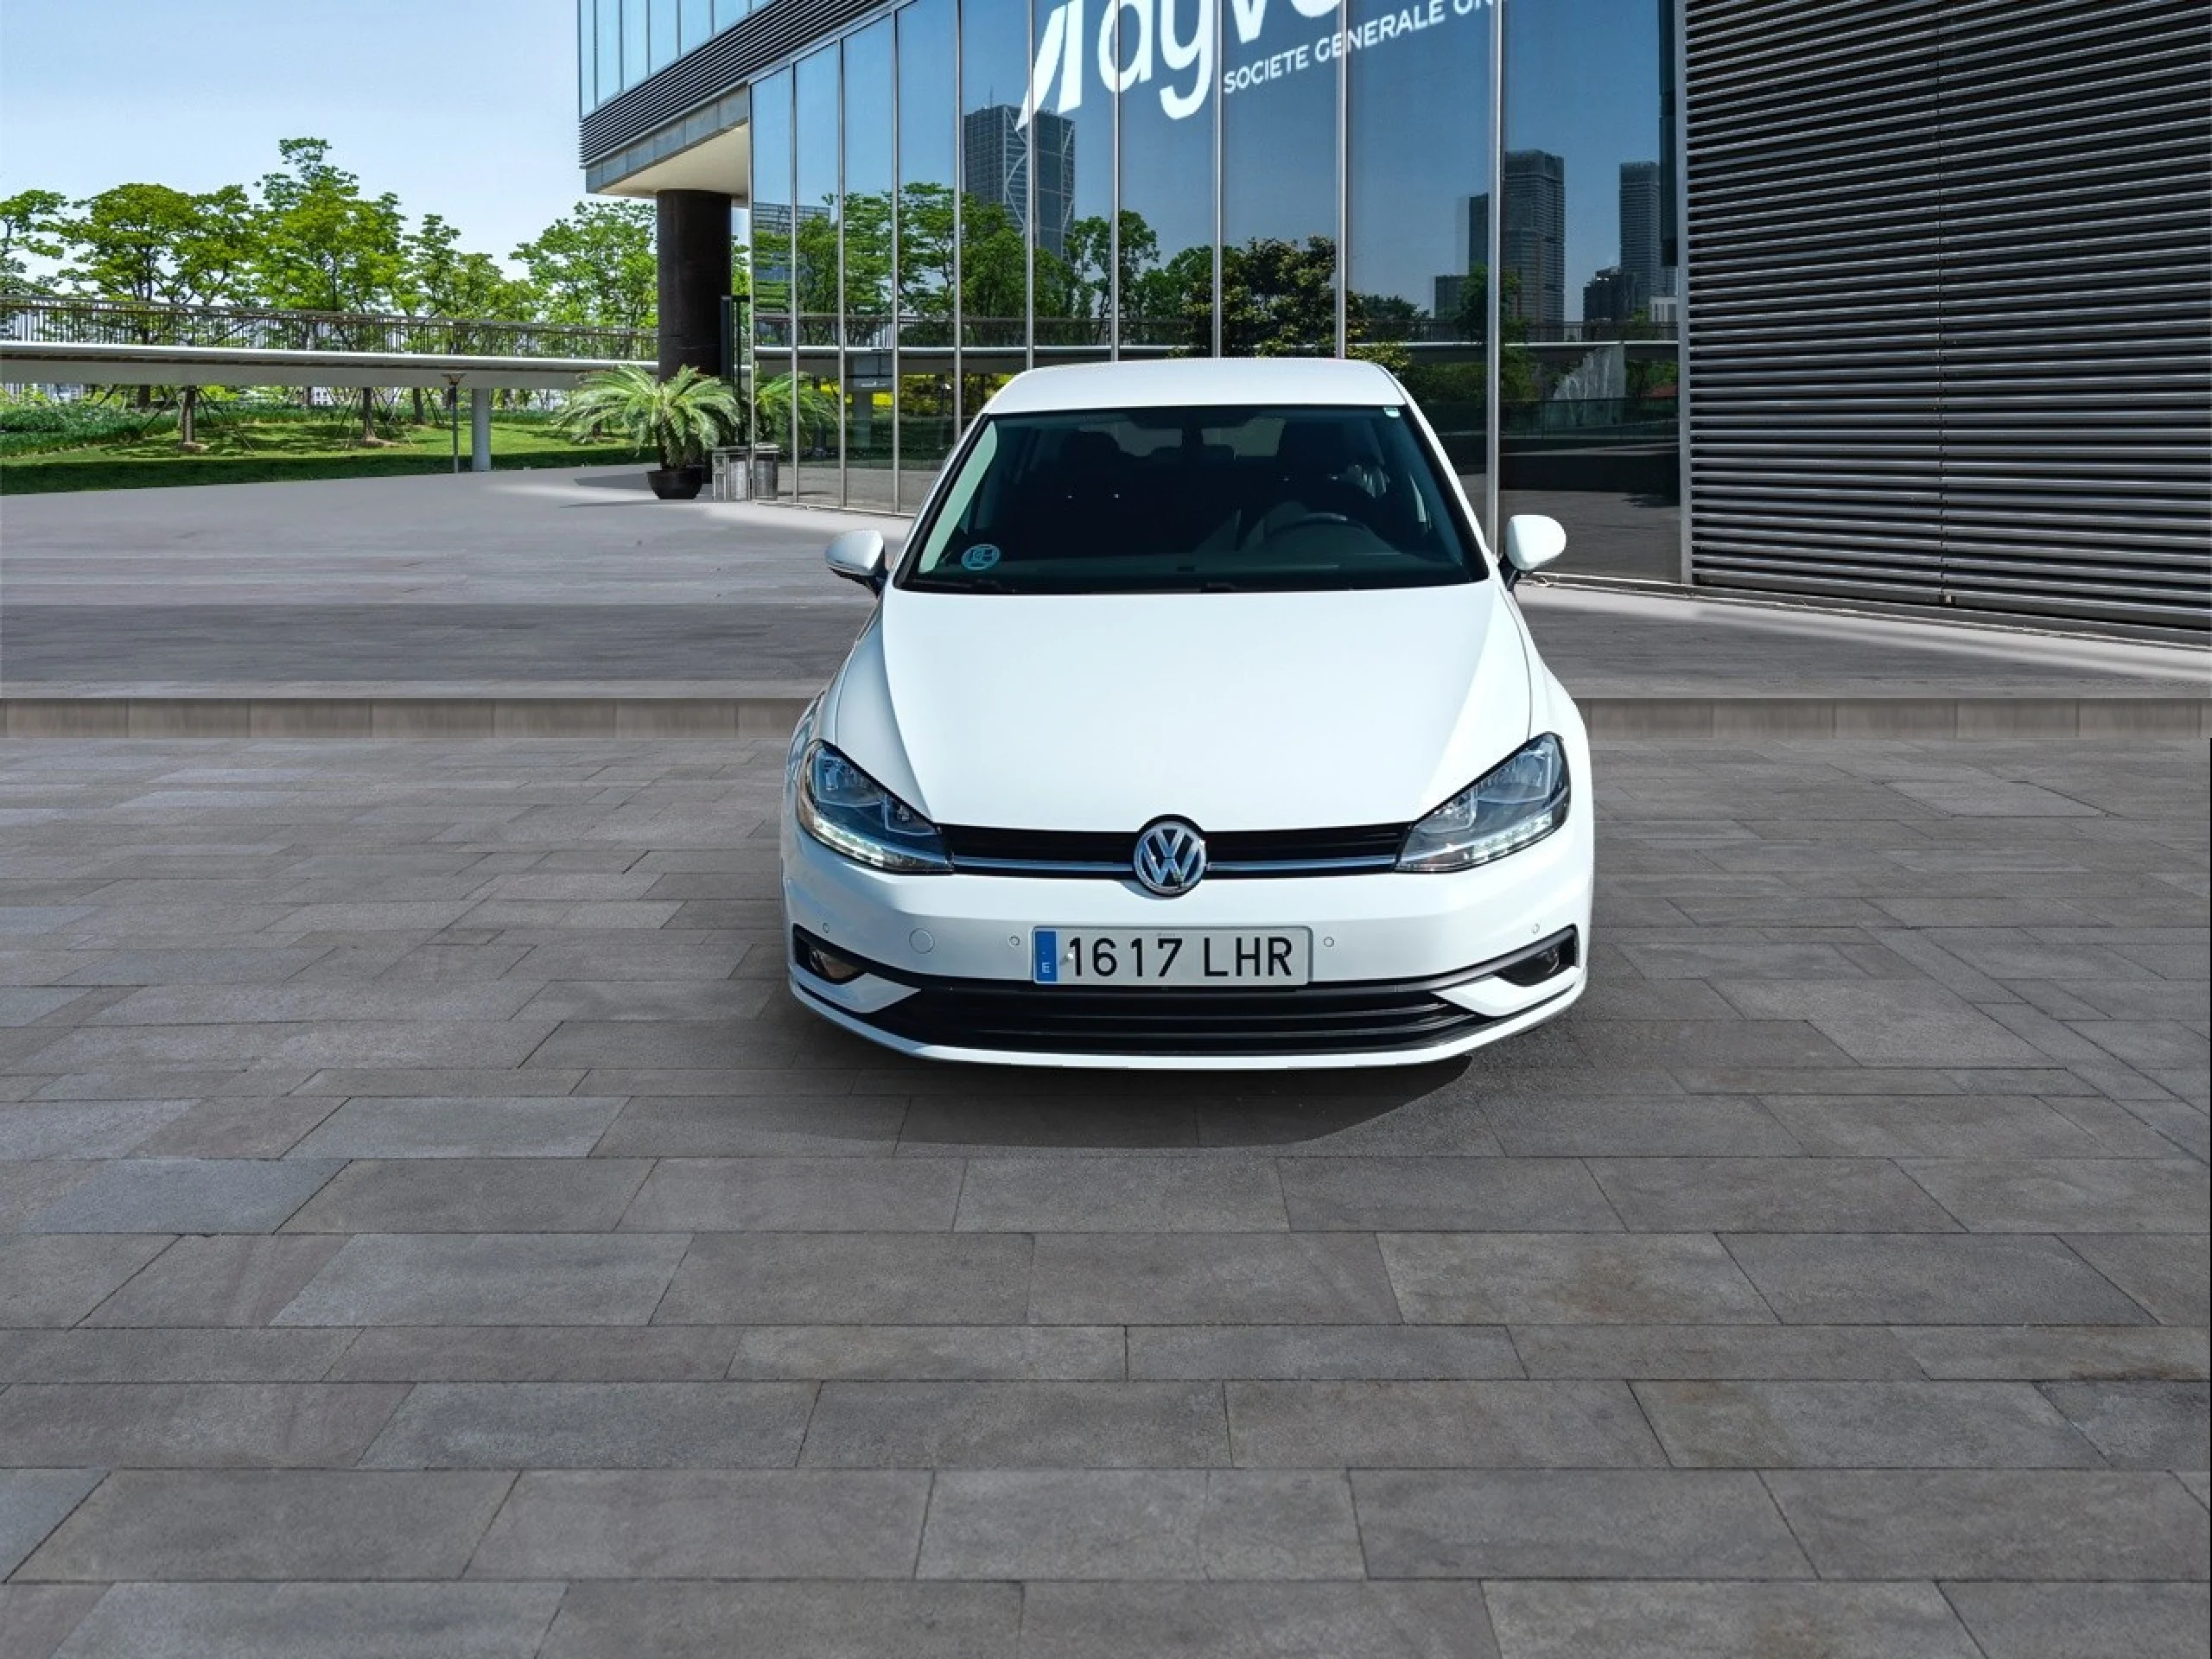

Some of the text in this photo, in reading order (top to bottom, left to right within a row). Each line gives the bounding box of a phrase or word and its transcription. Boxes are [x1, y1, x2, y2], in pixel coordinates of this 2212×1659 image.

[1223, 0, 1446, 93] SOCIETE GENERALE
[1134, 822, 1206, 894] VW
[1041, 962, 1052, 974] E
[1069, 937, 1293, 977] 1617 LHR
